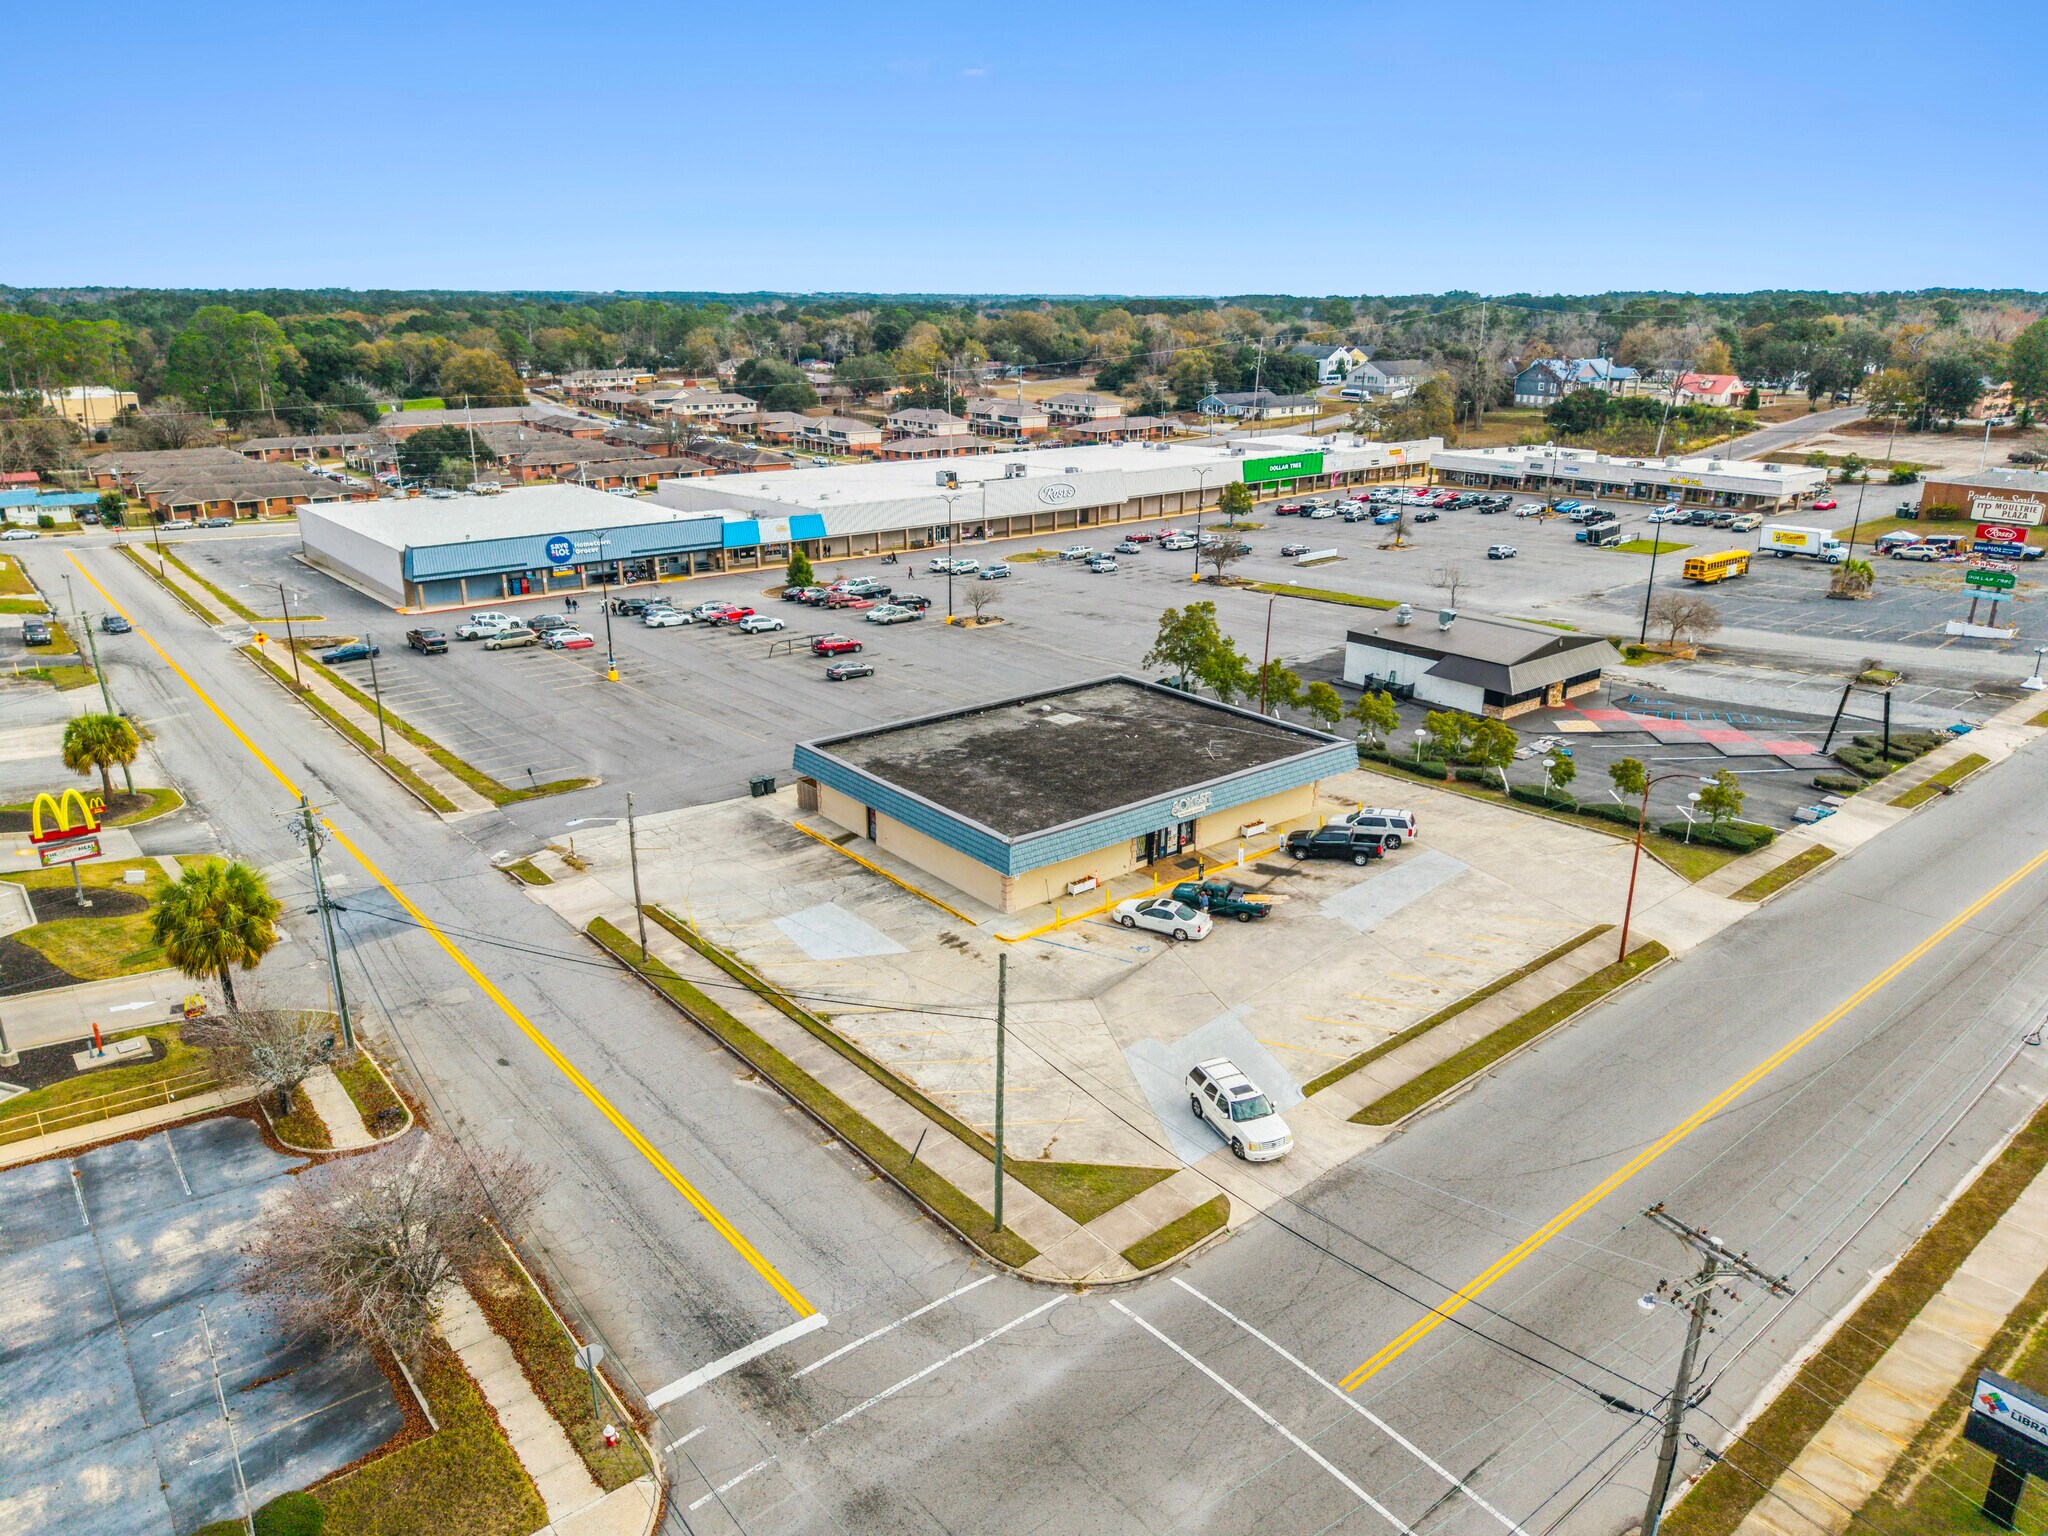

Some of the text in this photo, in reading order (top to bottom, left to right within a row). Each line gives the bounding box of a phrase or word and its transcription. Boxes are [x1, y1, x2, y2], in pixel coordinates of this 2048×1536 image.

[1269, 463, 1289, 472] DOLLAR
[1043, 487, 1072, 502] Roses
[1995, 503, 2038, 514] MOULTRIE
[2001, 511, 2028, 519] PLAZA
[1989, 527, 2014, 538] Roses
[550, 542, 568, 550] save
[574, 540, 611, 548] Hometown
[575, 547, 599, 555] Grocer
[2010, 1411, 2048, 1437] LIBRA
